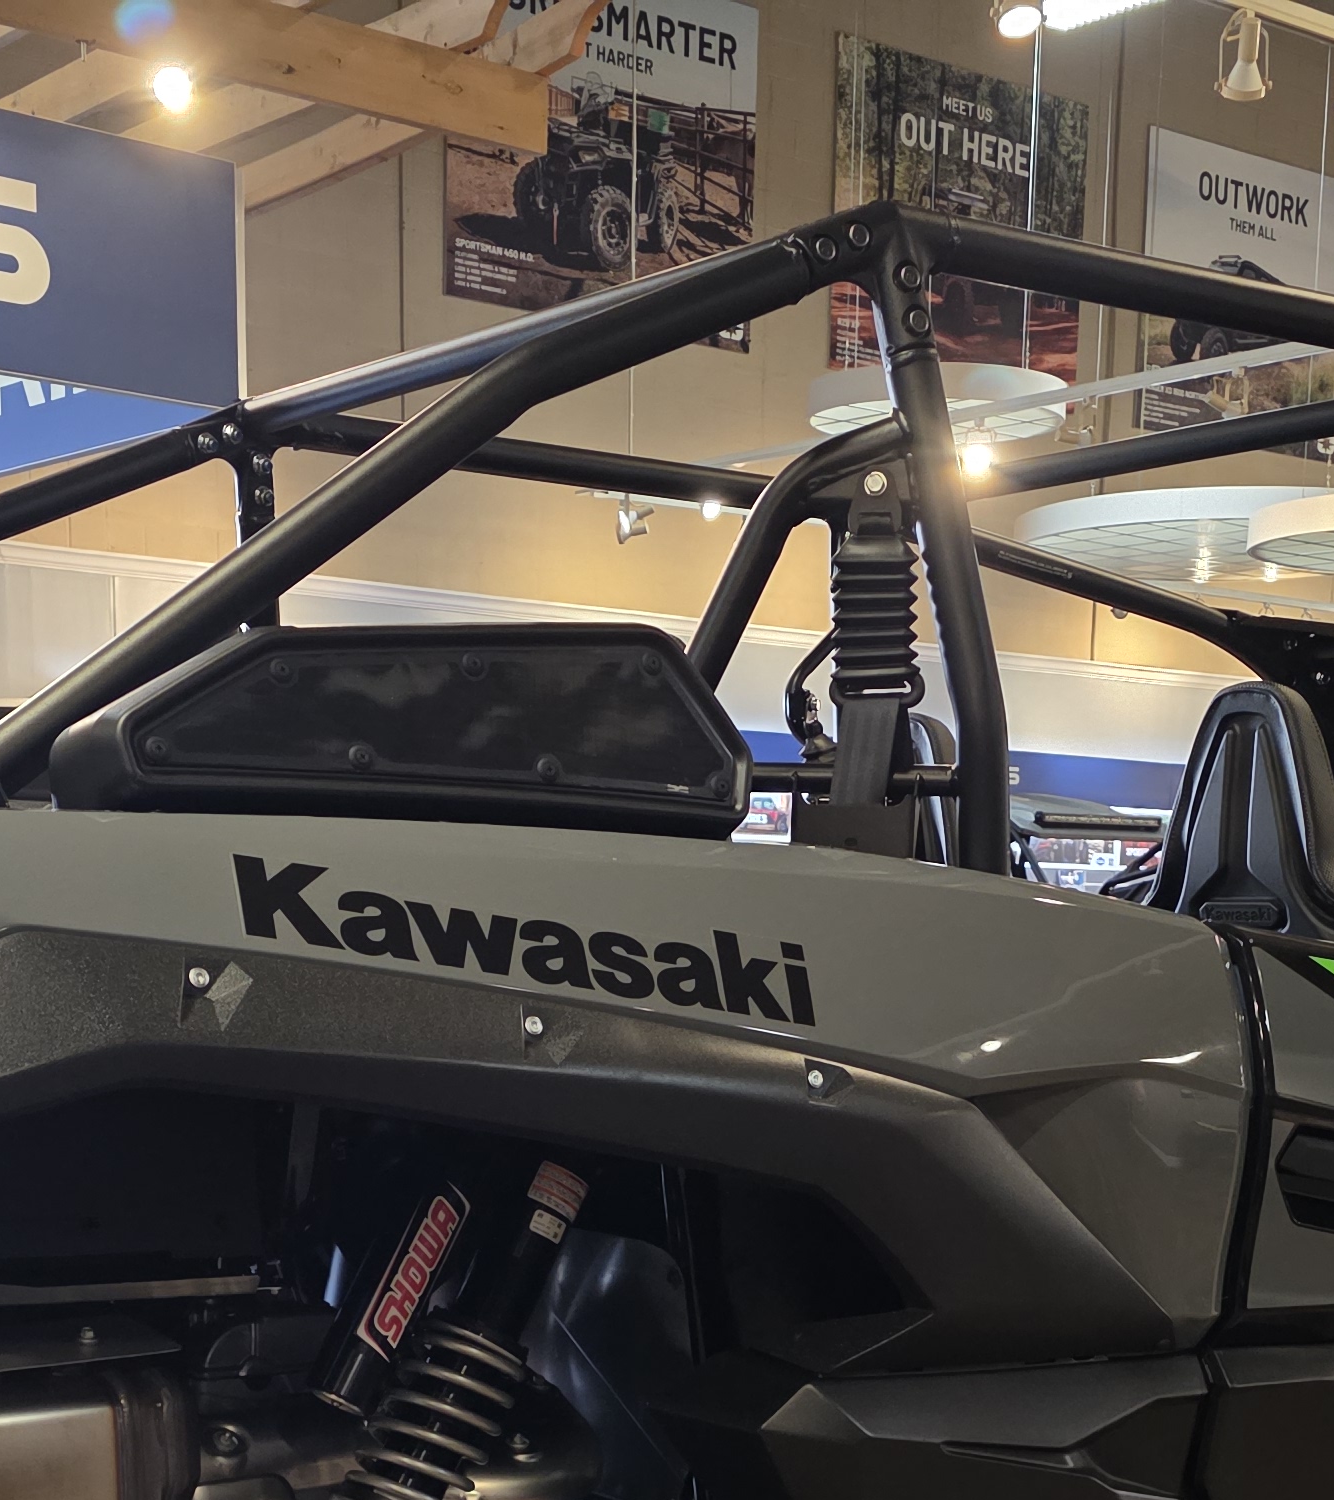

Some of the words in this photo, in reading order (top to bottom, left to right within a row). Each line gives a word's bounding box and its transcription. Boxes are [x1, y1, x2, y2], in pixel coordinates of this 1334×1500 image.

[596, 44, 654, 76] HARDER
[942, 95, 975, 117] MEET
[976, 104, 993, 123] US
[900, 112, 955, 156] OUT
[962, 127, 1031, 178] HERE
[1198, 171, 1310, 228] OUTWORK
[1229, 217, 1256, 237] THEM
[1257, 225, 1277, 242] ALL
[232, 853, 817, 1027] Kawasaki
[375, 1197, 458, 1347] SHOWA
